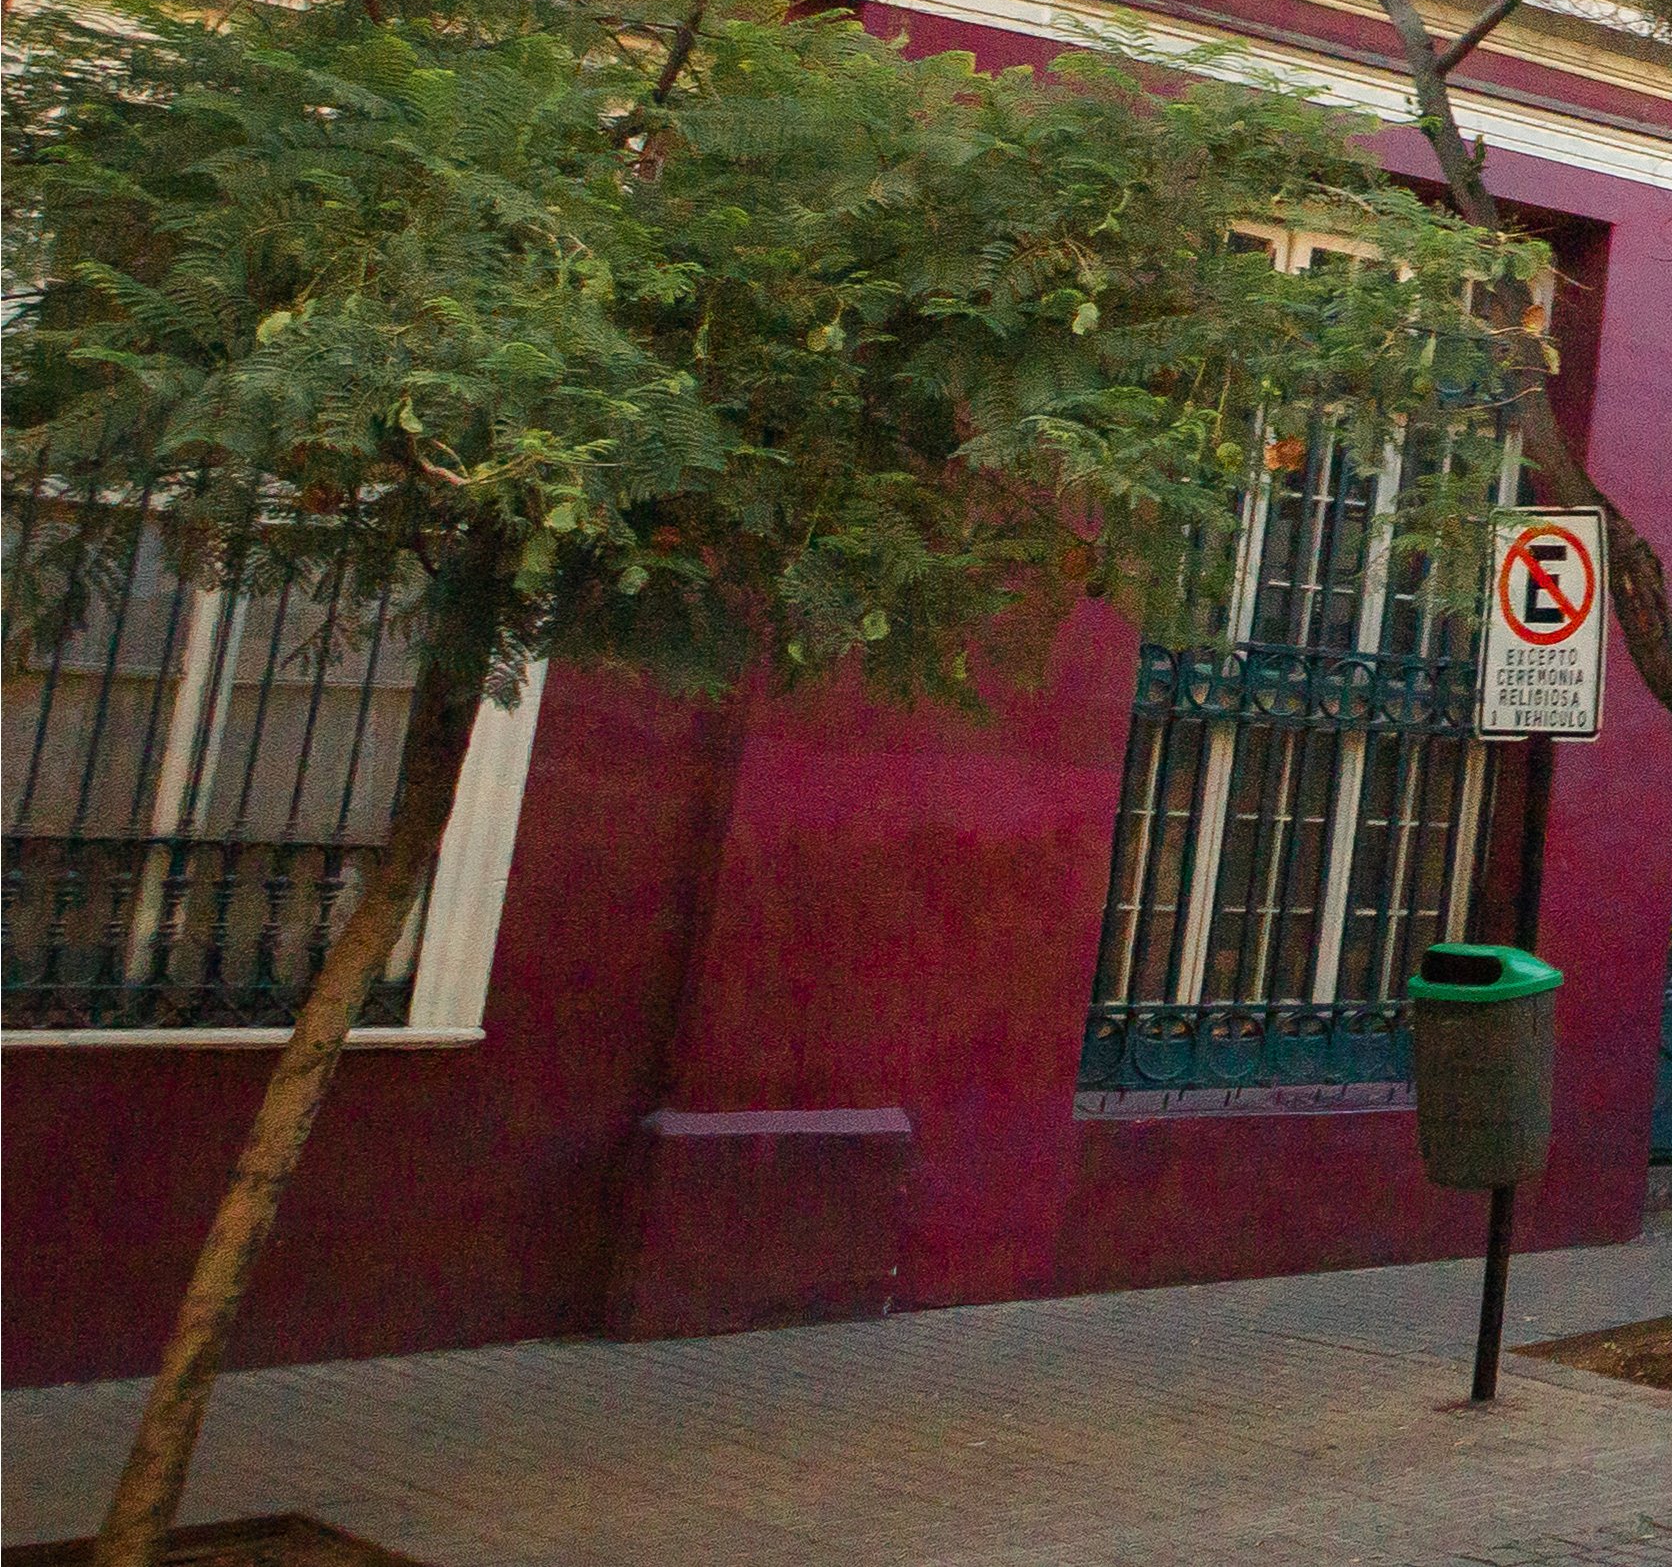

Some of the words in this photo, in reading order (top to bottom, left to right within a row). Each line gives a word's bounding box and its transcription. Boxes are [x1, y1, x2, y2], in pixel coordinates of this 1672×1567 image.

[1505, 648, 1577, 666] EXCEPTO
[1496, 668, 1584, 686] CEREMONIA
[1499, 688, 1580, 707] RELIGIOSA
